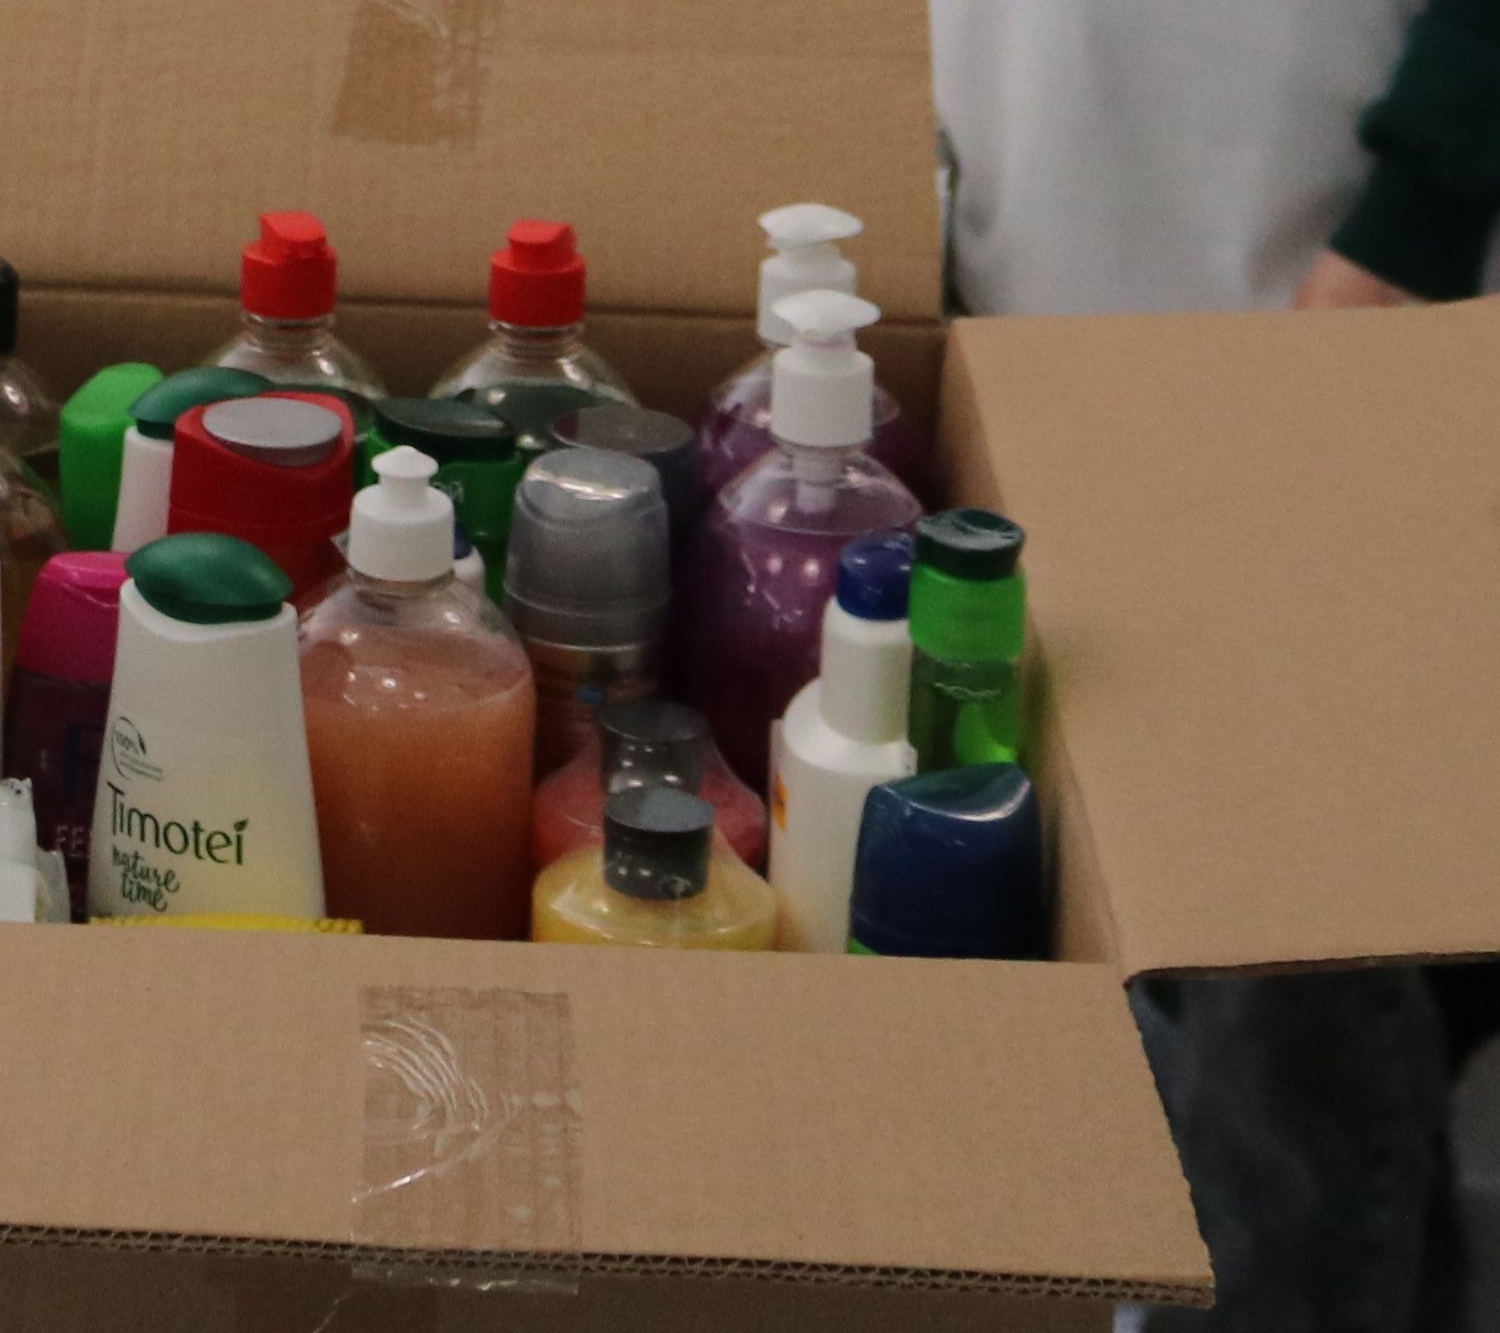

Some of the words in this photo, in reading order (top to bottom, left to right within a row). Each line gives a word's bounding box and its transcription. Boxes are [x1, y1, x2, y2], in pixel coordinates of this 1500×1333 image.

[107, 781, 248, 865] Timotei
[112, 844, 180, 893] nature
[122, 872, 167, 912] time
